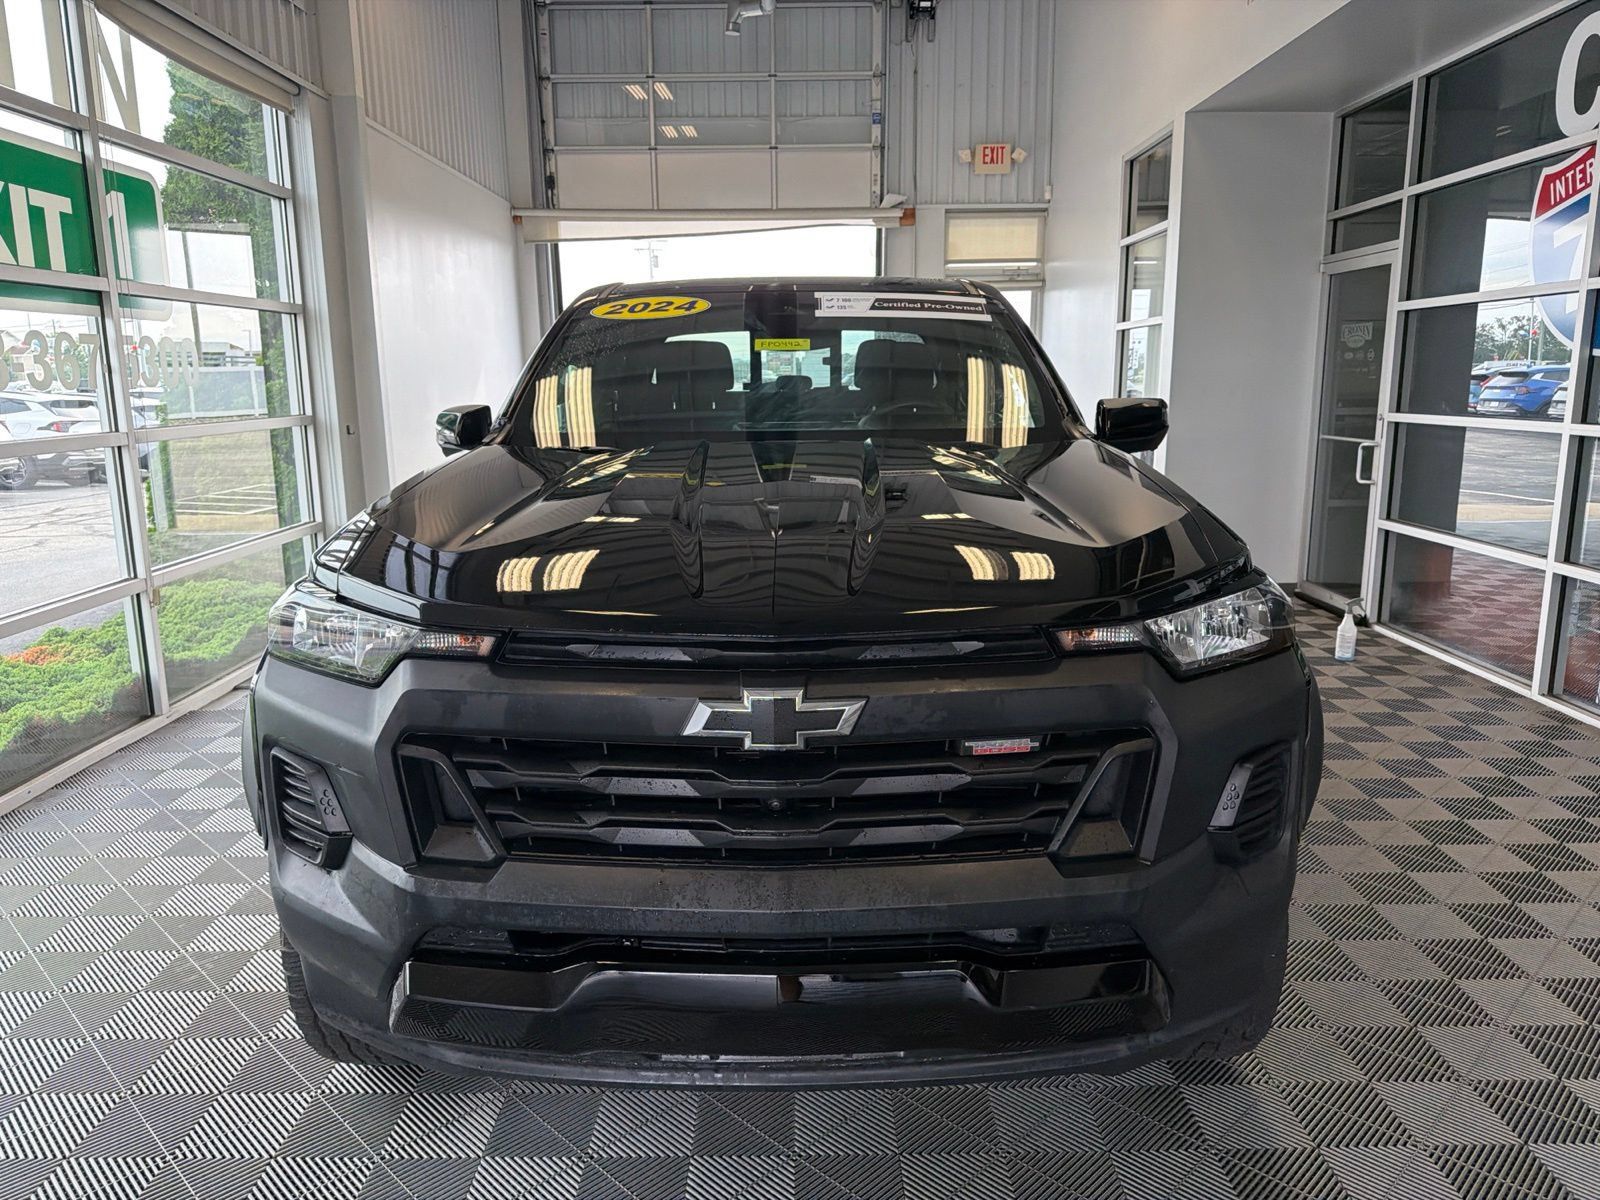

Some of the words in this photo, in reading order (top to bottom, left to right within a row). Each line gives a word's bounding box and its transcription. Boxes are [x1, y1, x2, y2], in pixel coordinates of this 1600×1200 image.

[982, 145, 1006, 165] EXIT
[602, 300, 698, 315] 2024
[873, 301, 921, 309] Certified
[923, 302, 983, 312] Pre-Owned
